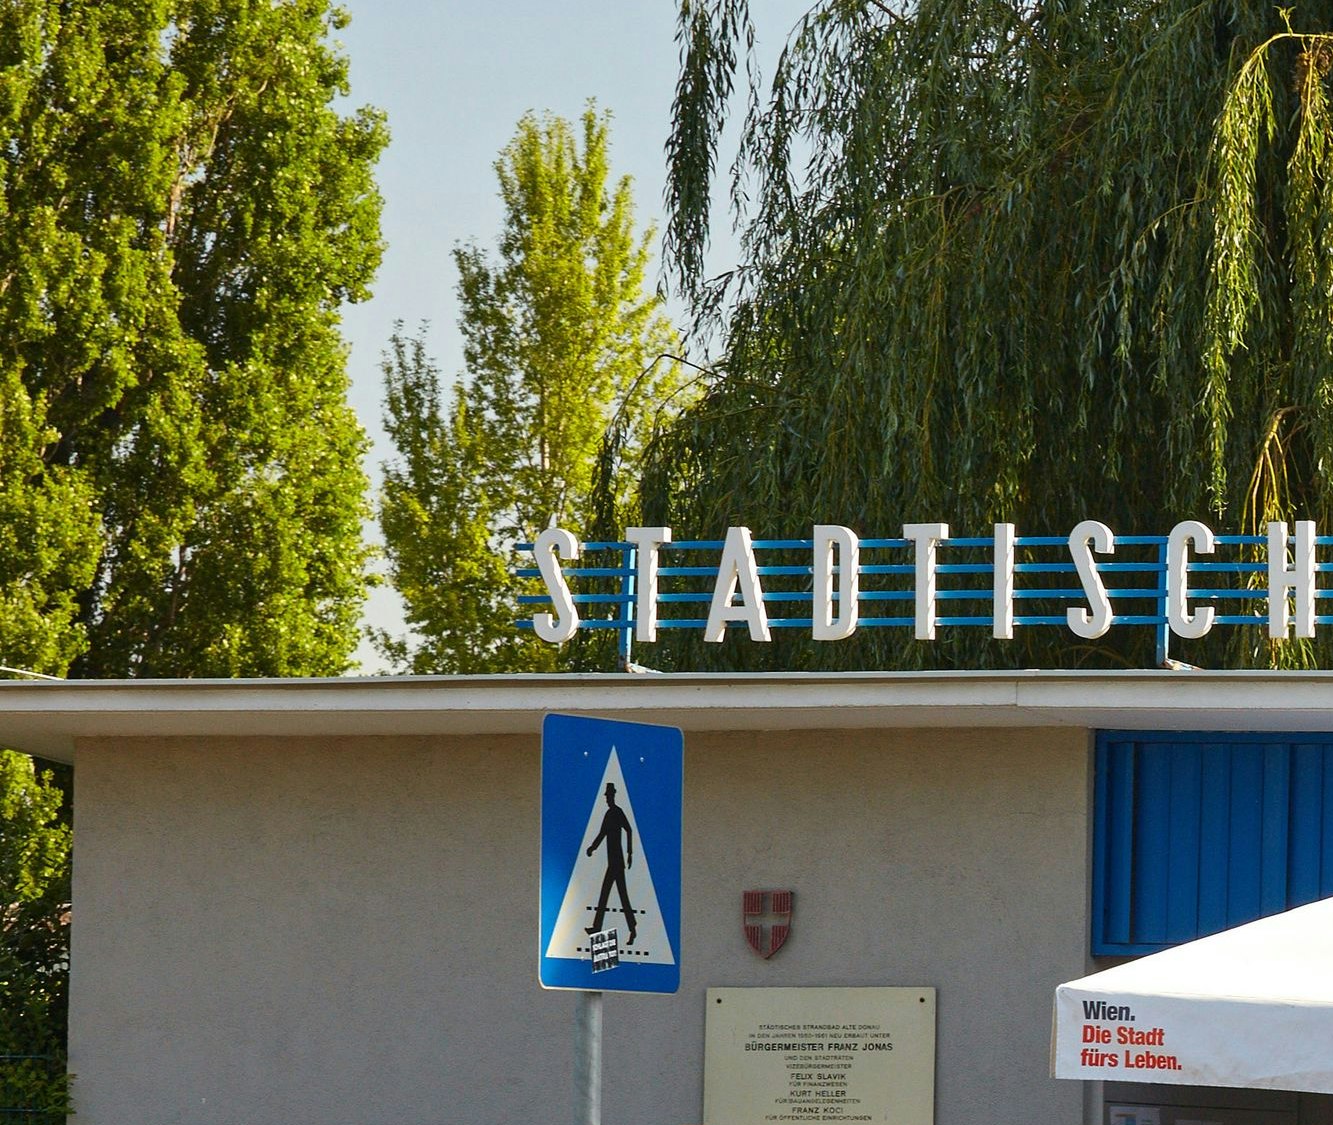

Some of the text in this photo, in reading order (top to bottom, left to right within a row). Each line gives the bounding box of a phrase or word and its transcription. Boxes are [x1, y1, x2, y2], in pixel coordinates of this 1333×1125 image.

[1082, 1000, 1136, 1021] Wien.
[1082, 1024, 1165, 1046] Die Stadt
[744, 1041, 894, 1051] BÜRGERMEISTER FRANZ JONAS
[1080, 1047, 1182, 1071] fürs Leben.
